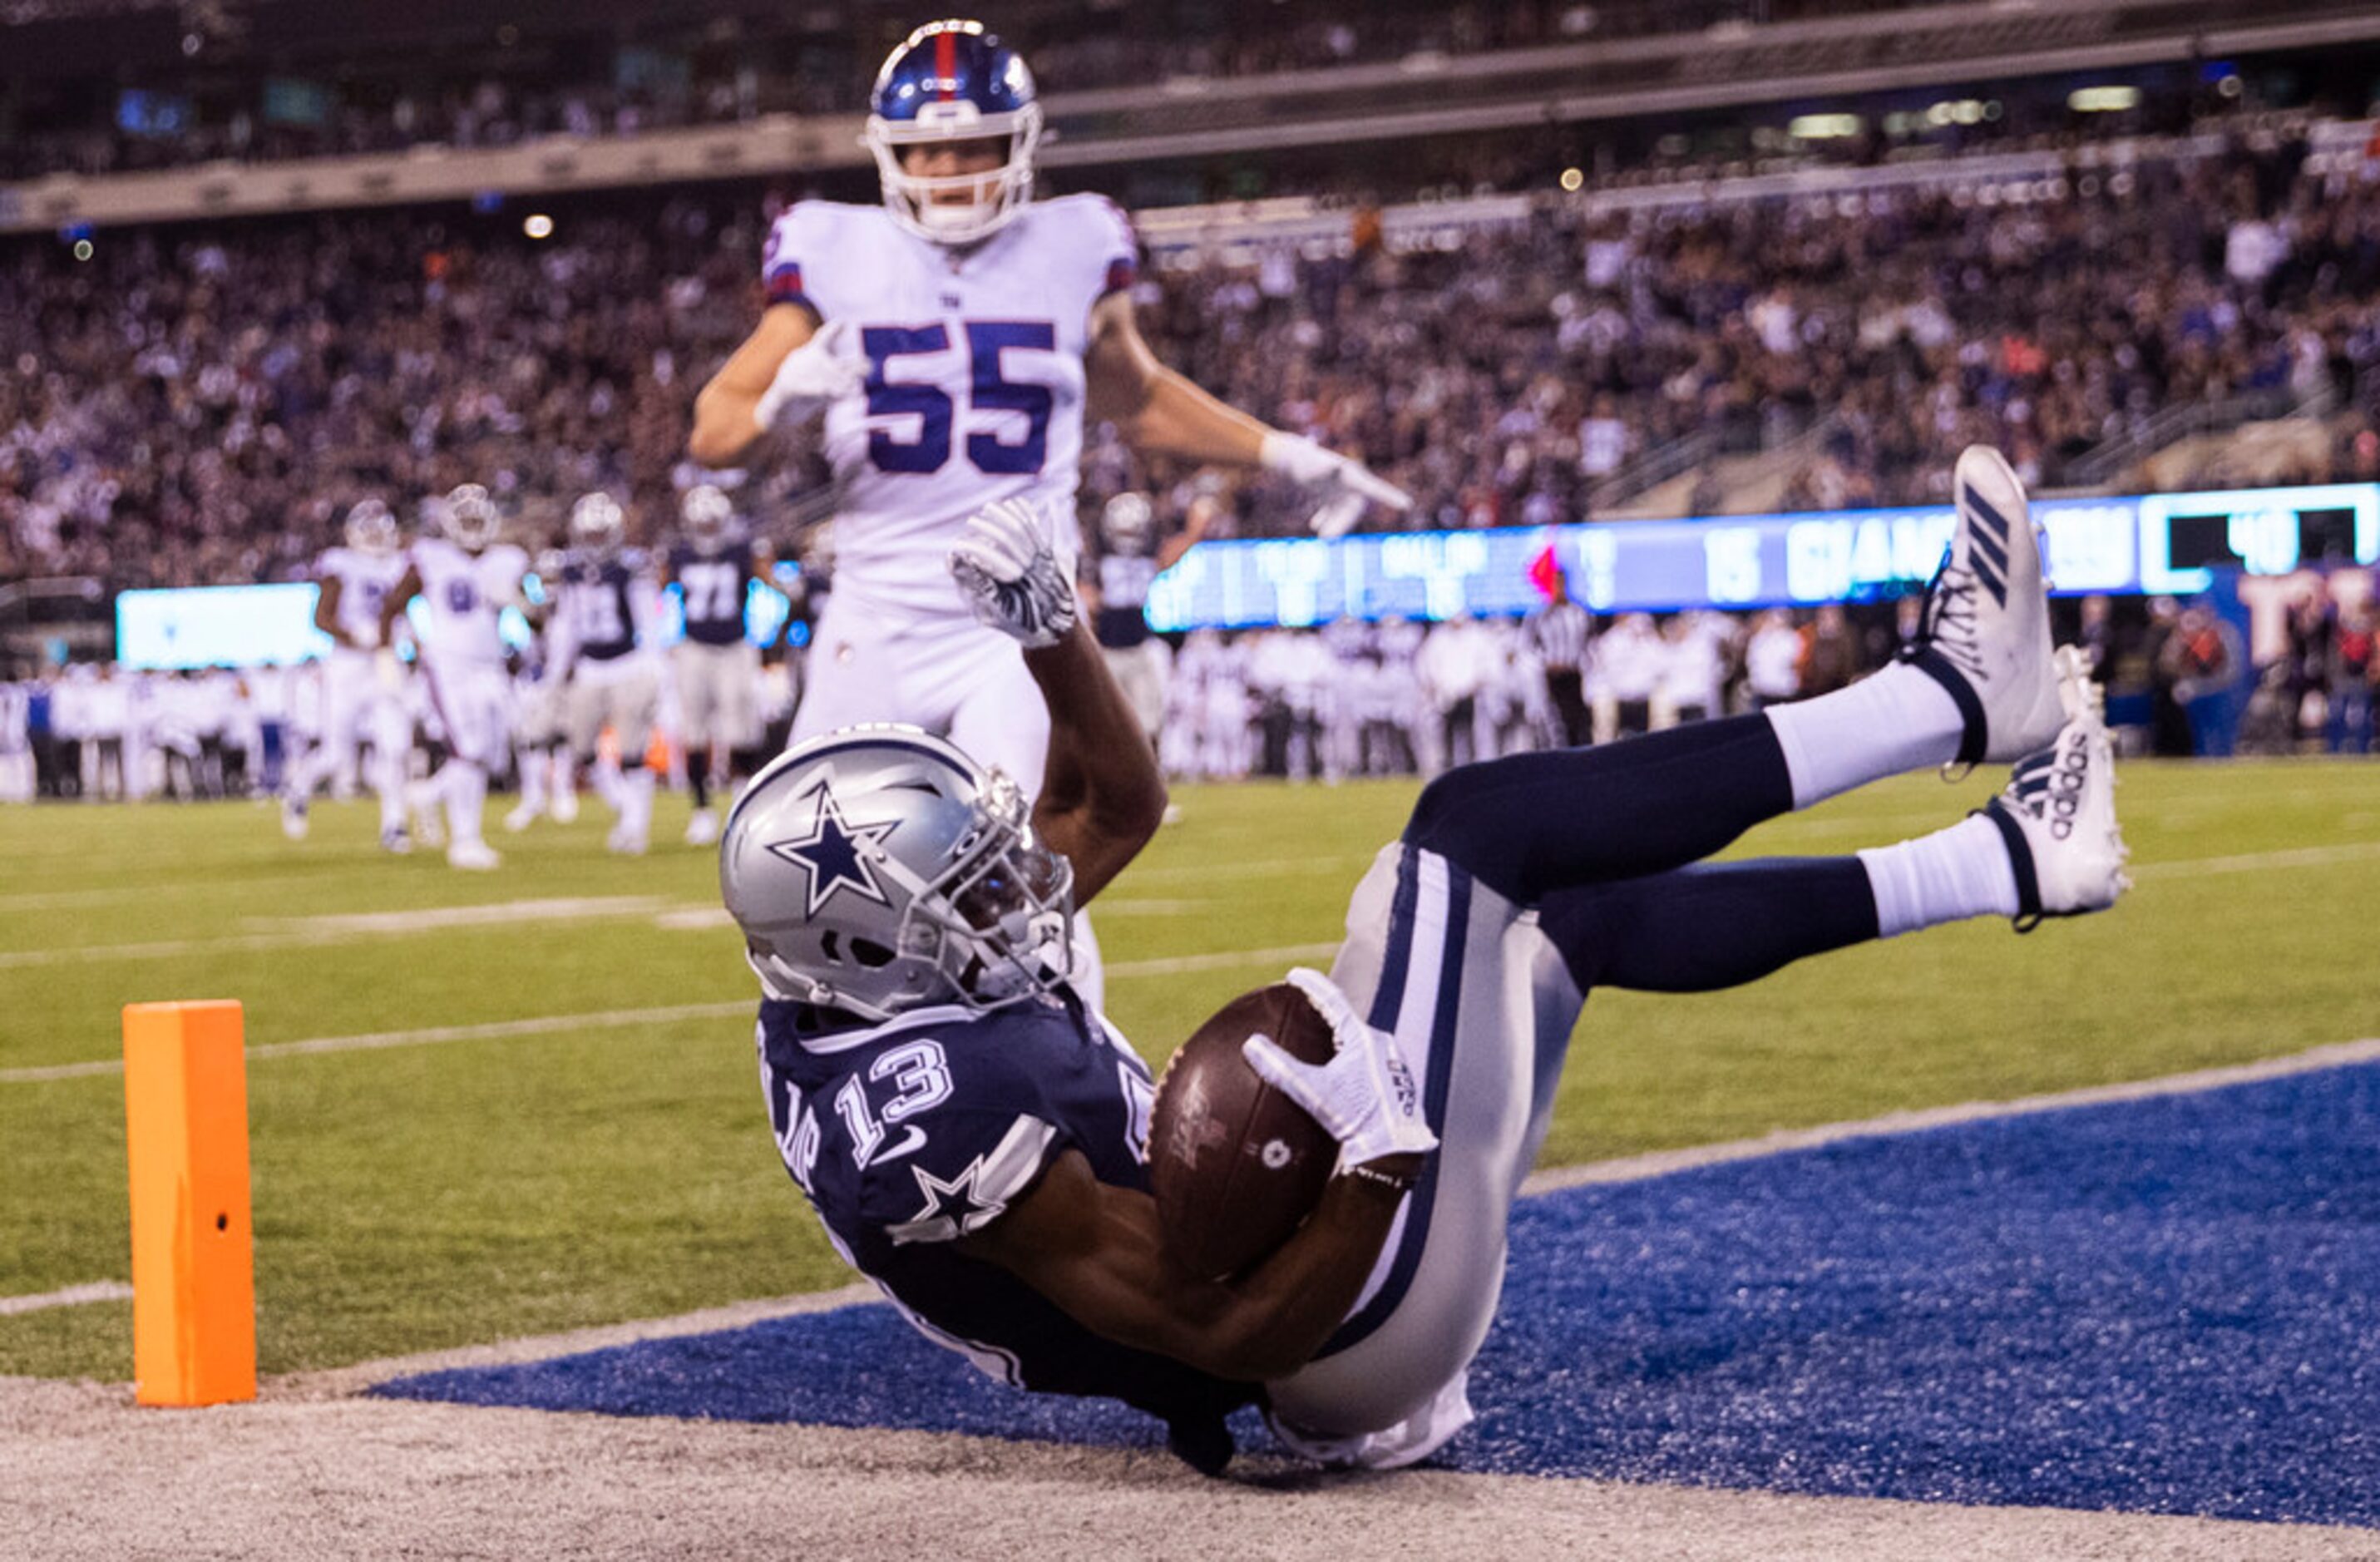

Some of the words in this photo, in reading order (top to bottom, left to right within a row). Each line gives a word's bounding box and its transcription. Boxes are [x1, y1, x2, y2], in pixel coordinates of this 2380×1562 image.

[862, 322, 1054, 474] 55
[2051, 734, 2088, 840] adidas
[834, 1038, 954, 1172] 13
